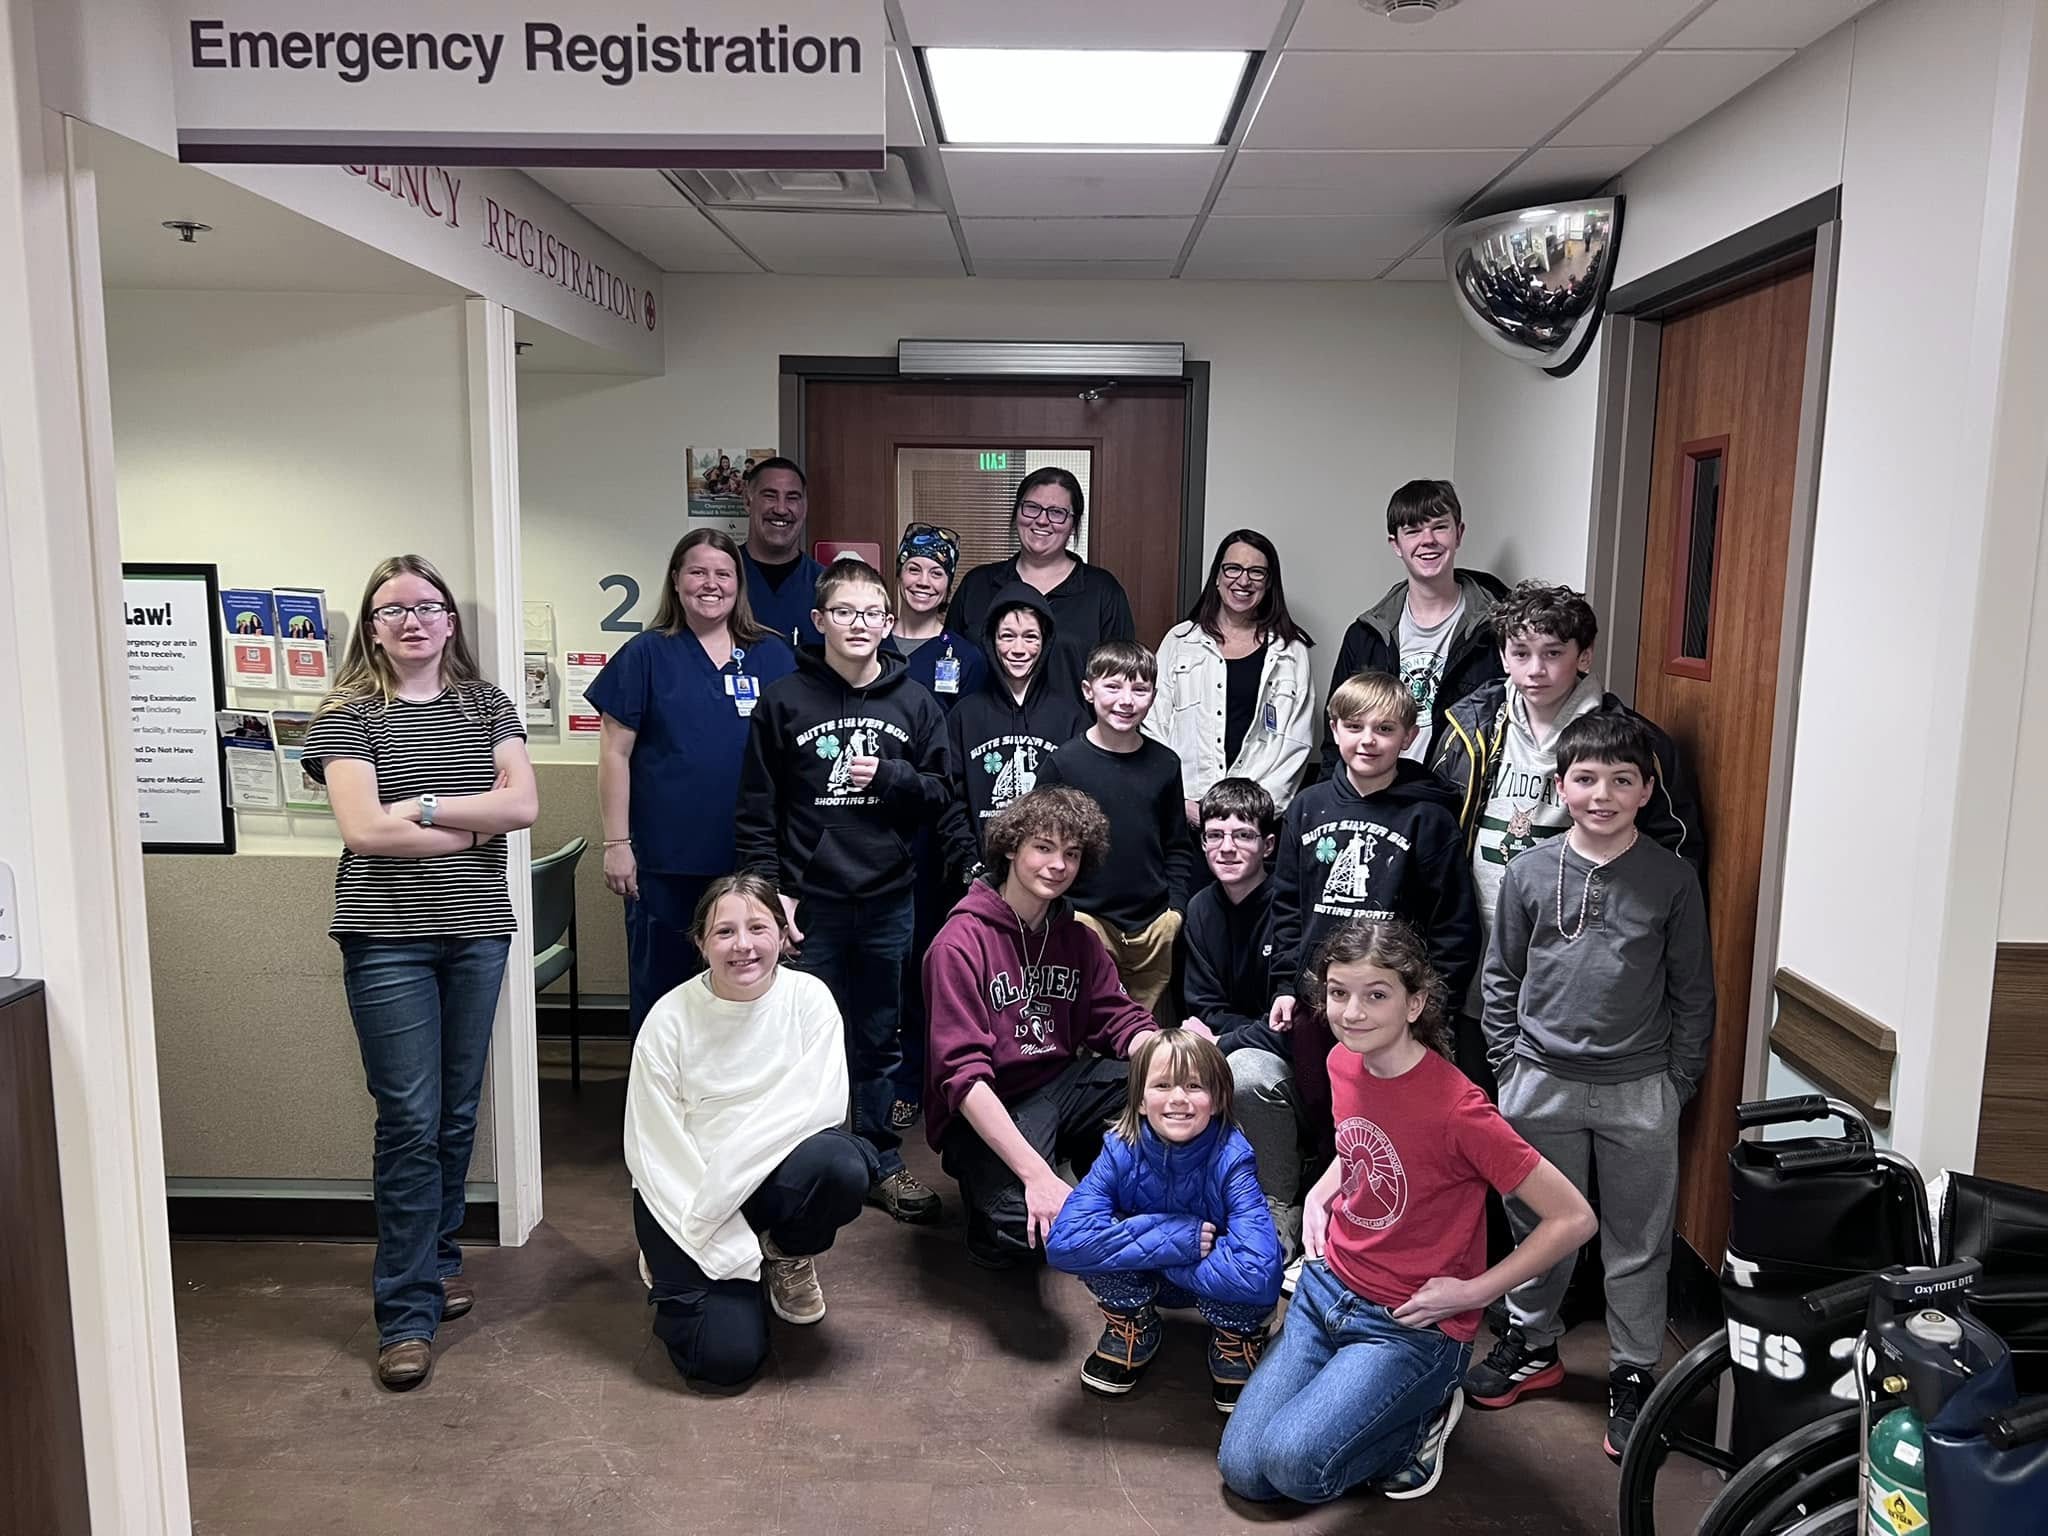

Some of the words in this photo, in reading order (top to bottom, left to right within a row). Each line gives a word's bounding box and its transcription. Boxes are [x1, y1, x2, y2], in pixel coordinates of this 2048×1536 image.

[191, 19, 504, 85] Emergency
[525, 22, 863, 85] Registration
[484, 196, 637, 325] REGISTRATION
[598, 573, 644, 633] 2
[123, 601, 172, 626] Law!
[127, 640, 160, 648] ergency
[189, 639, 198, 647] in
[149, 694, 197, 702] Examination
[796, 719, 837, 748] BUTTE
[174, 746, 195, 754] Have
[813, 796, 866, 807] SHOOTING
[1300, 819, 1339, 847] BUTTE
[1353, 908, 1396, 921] SPORTS
[1014, 1023, 1029, 1038] 19
[1043, 1018, 1055, 1034] 10
[1914, 1280, 1958, 1295] OxyTOTE
